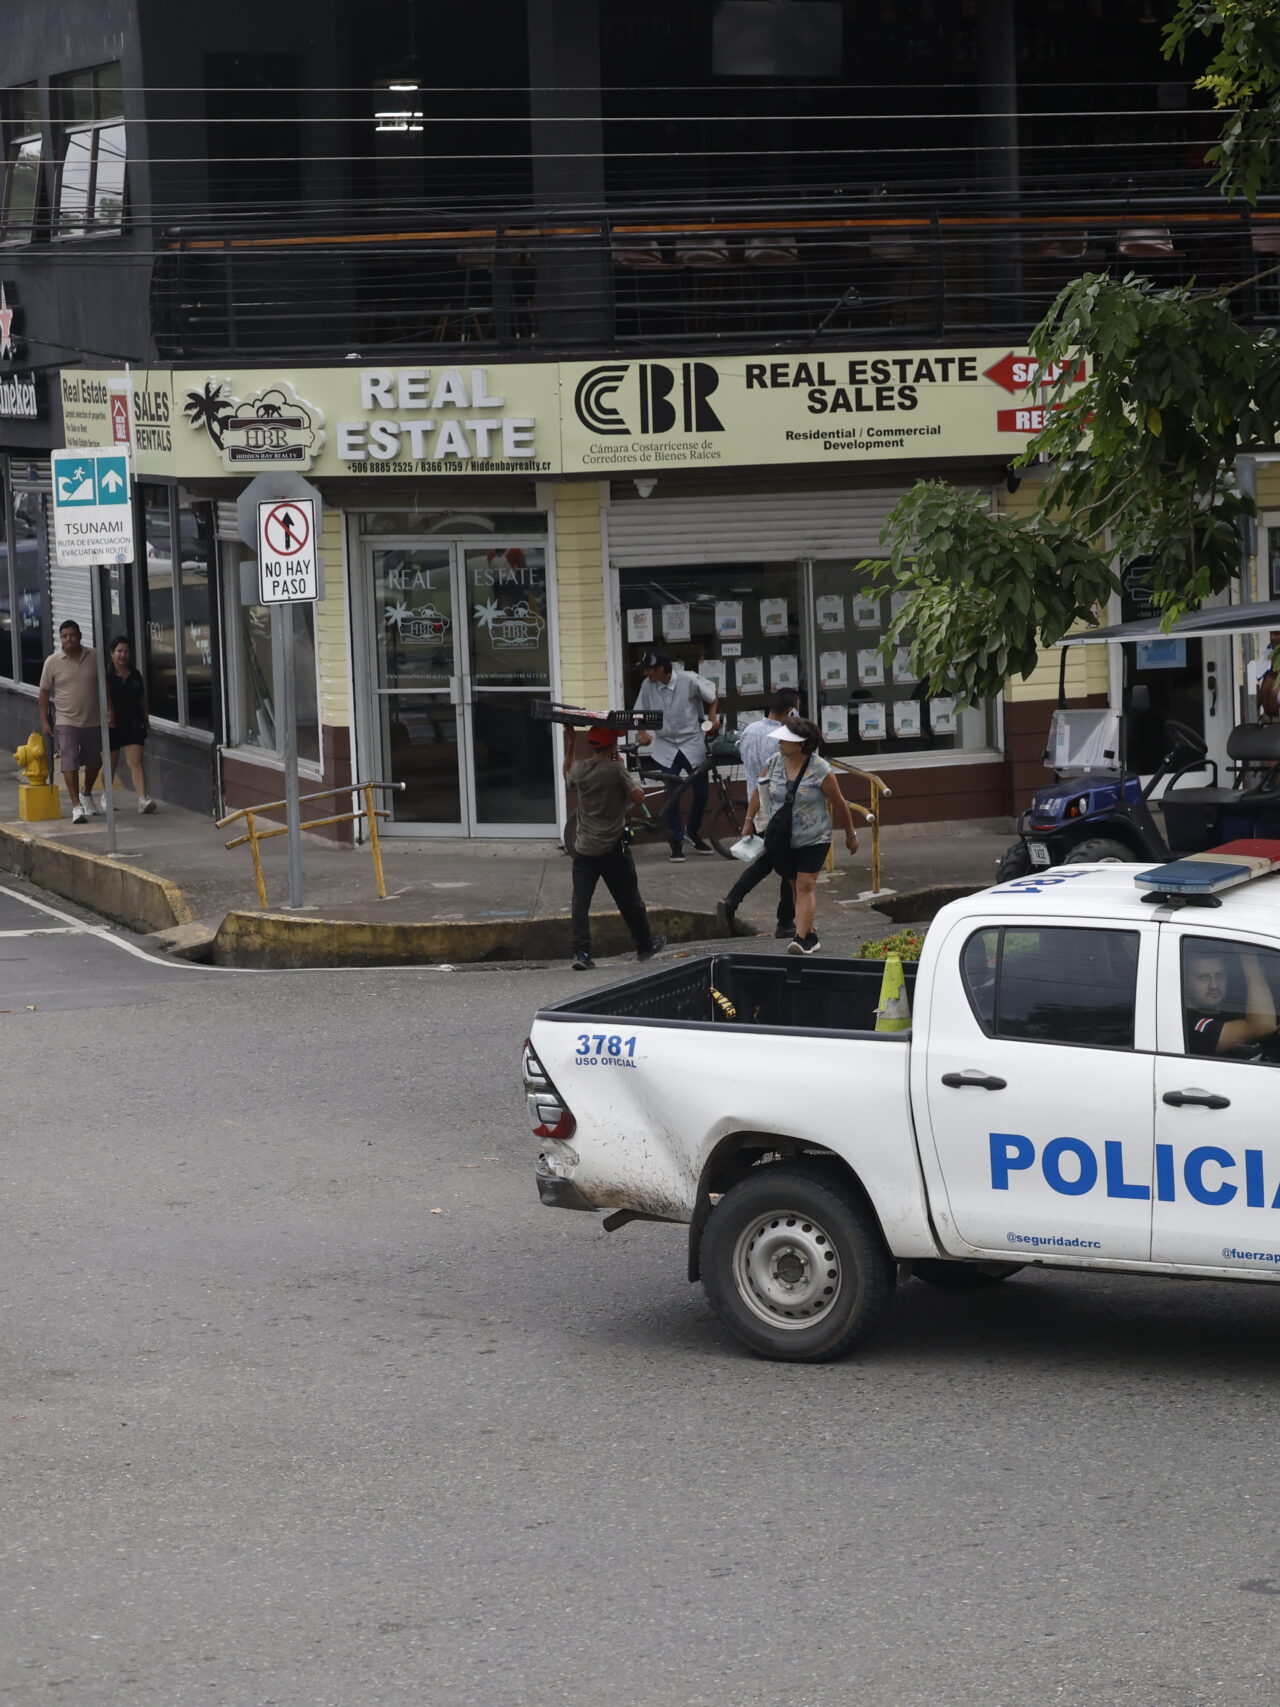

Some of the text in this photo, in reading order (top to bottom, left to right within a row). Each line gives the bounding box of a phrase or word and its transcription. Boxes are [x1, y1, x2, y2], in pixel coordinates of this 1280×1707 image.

[745, 357, 978, 389] REAL ESTATE
[63, 378, 108, 404] Real Estate
[360, 369, 504, 410] REAL
[134, 391, 170, 422] SALES
[807, 385, 919, 414] SALES
[136, 429, 172, 452] RENTALS
[245, 429, 289, 447] HBR
[337, 418, 536, 461] ESTATE
[786, 428, 856, 441] Residential
[866, 425, 942, 438] Commercial
[631, 441, 699, 453] Costarricense
[701, 440, 713, 449] de
[823, 438, 905, 451] Development
[347, 461, 368, 473] +506
[370, 461, 391, 473] 8885
[393, 461, 413, 473] 2525
[421, 460, 442, 472] 8366
[444, 460, 463, 472] 1759
[471, 459, 551, 473] Hiddenbayrealty.cr
[582, 452, 637, 464] Corredores
[639, 452, 652, 462] de
[654, 450, 687, 461] Bienes
[64, 521, 123, 535] TSUNAMI
[57, 539, 76, 547] RUTA
[62, 546, 129, 557] EVACUATION ROUTE
[265, 559, 311, 578] NO HAY
[272, 577, 307, 596] PASO
[388, 567, 540, 590] REAL ESTATE
[410, 623, 434, 635] HBR
[502, 625, 528, 638] HBR
[575, 1034, 638, 1058] 3781
[575, 1057, 638, 1069] USO OFICIAL
[1006, 1231, 1101, 1249] @seguridadcrc
